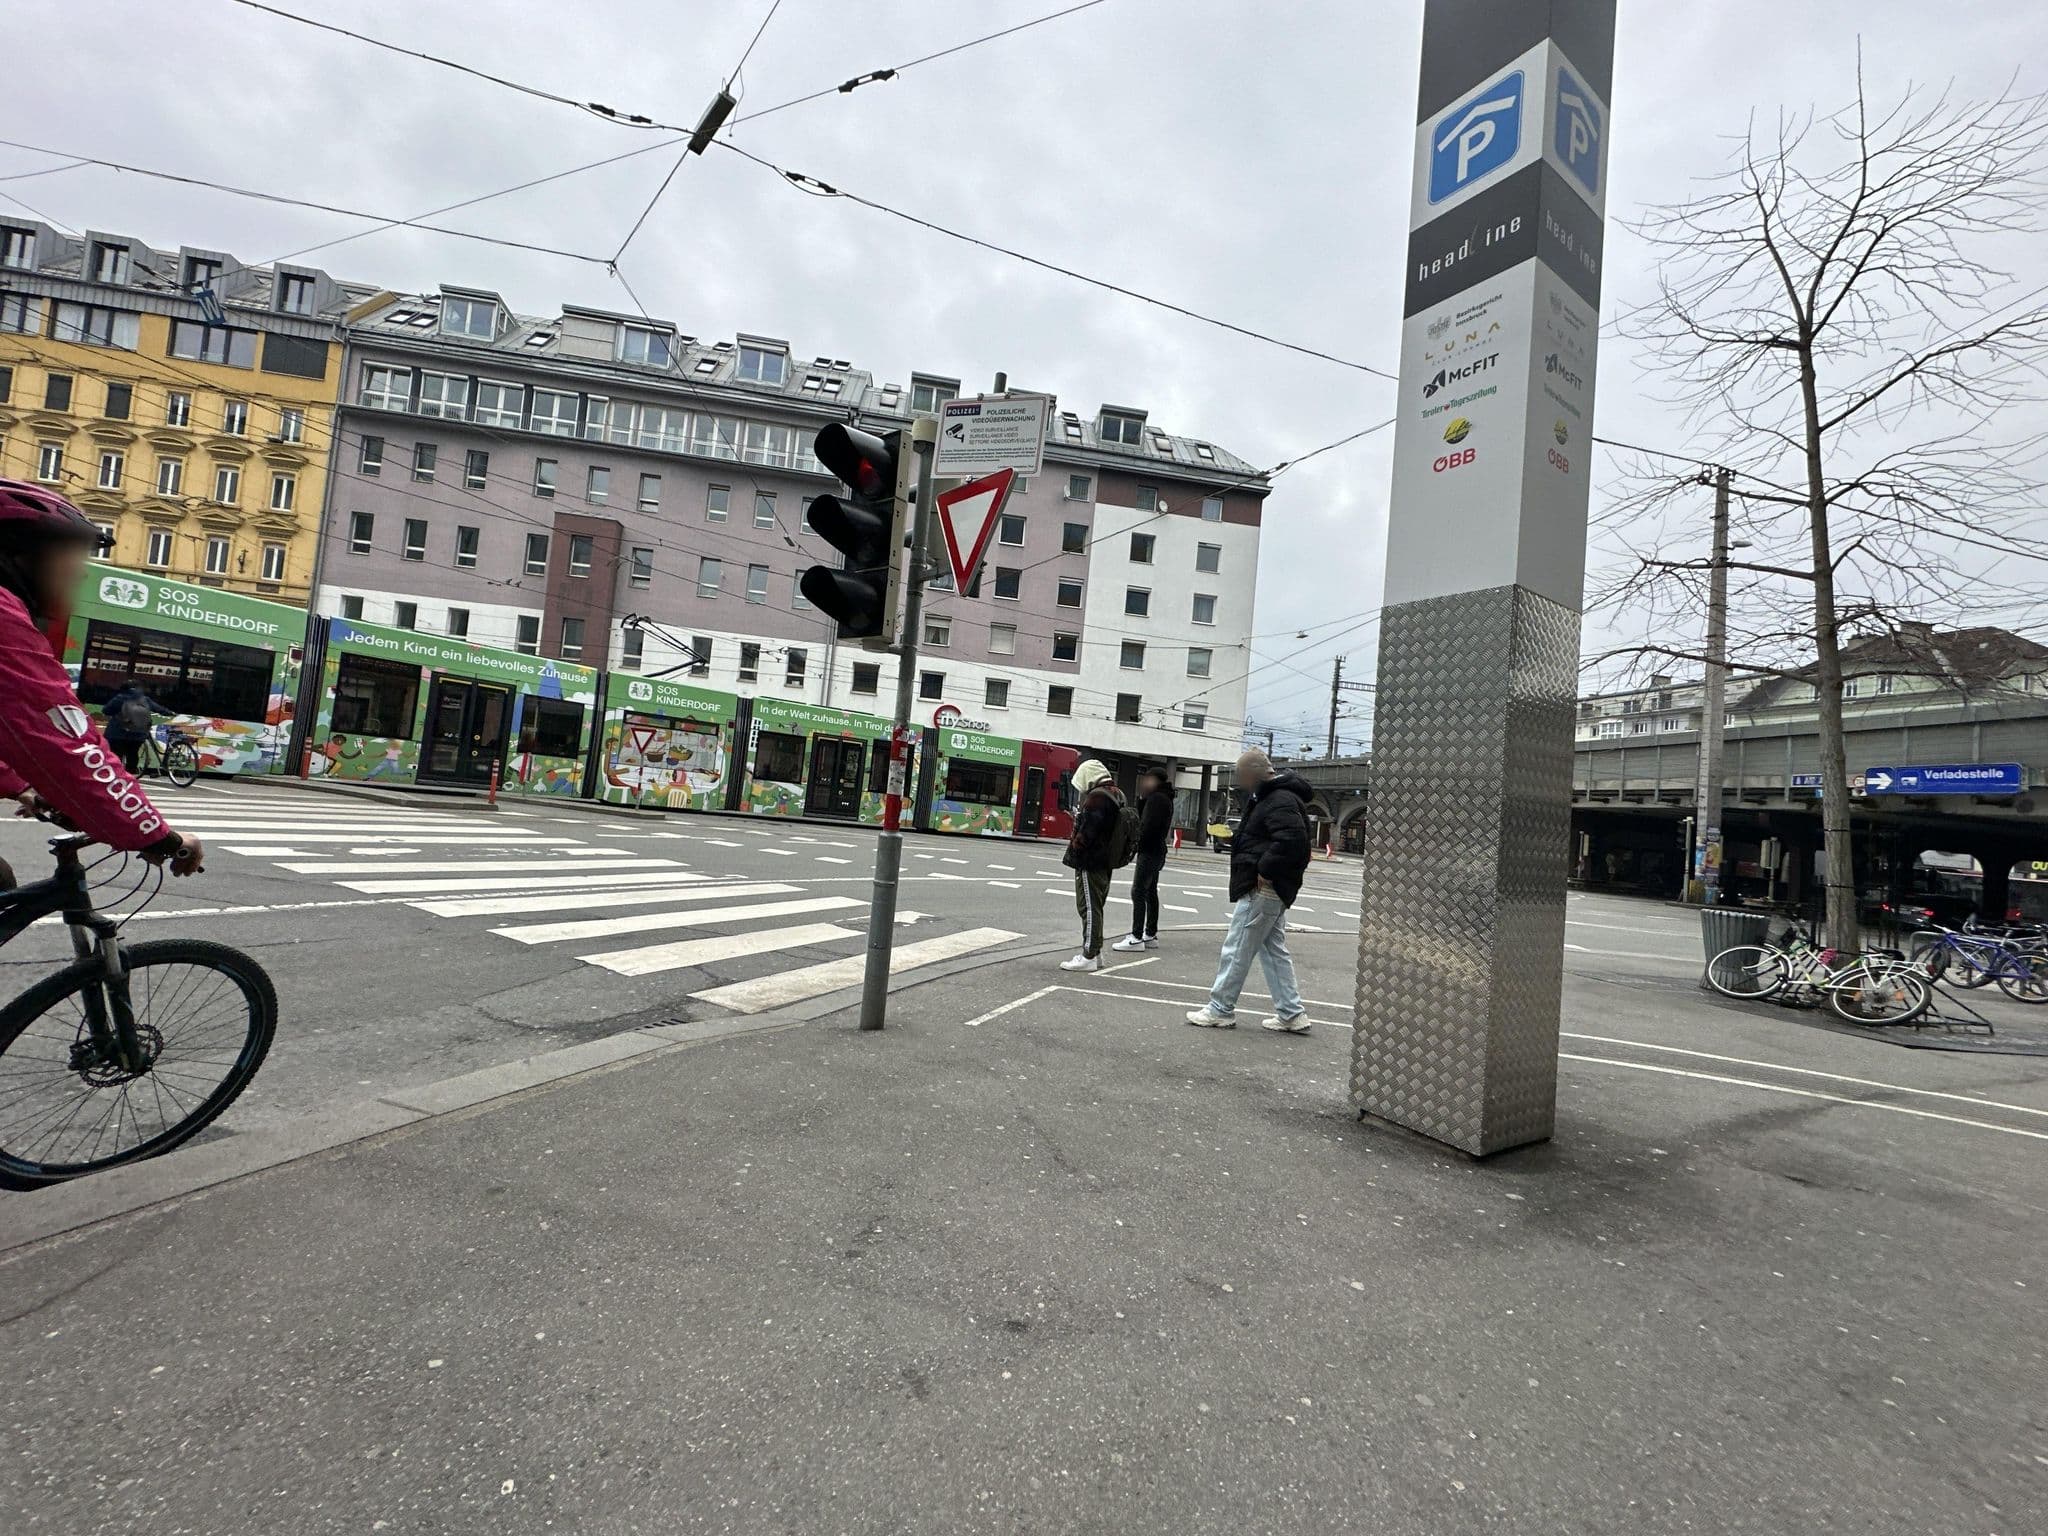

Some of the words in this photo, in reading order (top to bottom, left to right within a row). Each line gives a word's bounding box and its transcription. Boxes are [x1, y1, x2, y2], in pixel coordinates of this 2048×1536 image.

[1569, 112, 1588, 164] P
[1457, 120, 1496, 183] P
[1546, 209, 1596, 274] headine
[1425, 322, 1500, 360] LUNA
[1448, 353, 1499, 384] McFIT
[947, 408, 976, 416] POLIZEI
[972, 415, 1035, 424] VIDEOÜBERWACHUNG
[986, 408, 1026, 416] POLIZEILICHE
[1433, 448, 1476, 472] ÖBB
[1547, 448, 1569, 474] ÖBB
[158, 587, 200, 605] SOS
[156, 601, 279, 634] KINDERDORF
[344, 630, 399, 650] Jedem
[403, 641, 437, 657] Kind
[441, 650, 462, 661] ein
[466, 650, 534, 674] liebevolles
[537, 665, 588, 684] Zuhause
[656, 685, 679, 696] SOS
[656, 695, 721, 712] KINDERDORF
[760, 704, 769, 713] In
[771, 706, 788, 716] der
[789, 709, 810, 720] Welt
[812, 713, 852, 727] zuhause.
[854, 719, 863, 727] In
[864, 720, 883, 731] Tirol
[969, 744, 1016, 757] KINDERDORF
[970, 735, 986, 744] SOS
[1924, 767, 2004, 780] Verladestelle
[72, 742, 161, 835] foodora
[2031, 860, 2048, 871] OU
